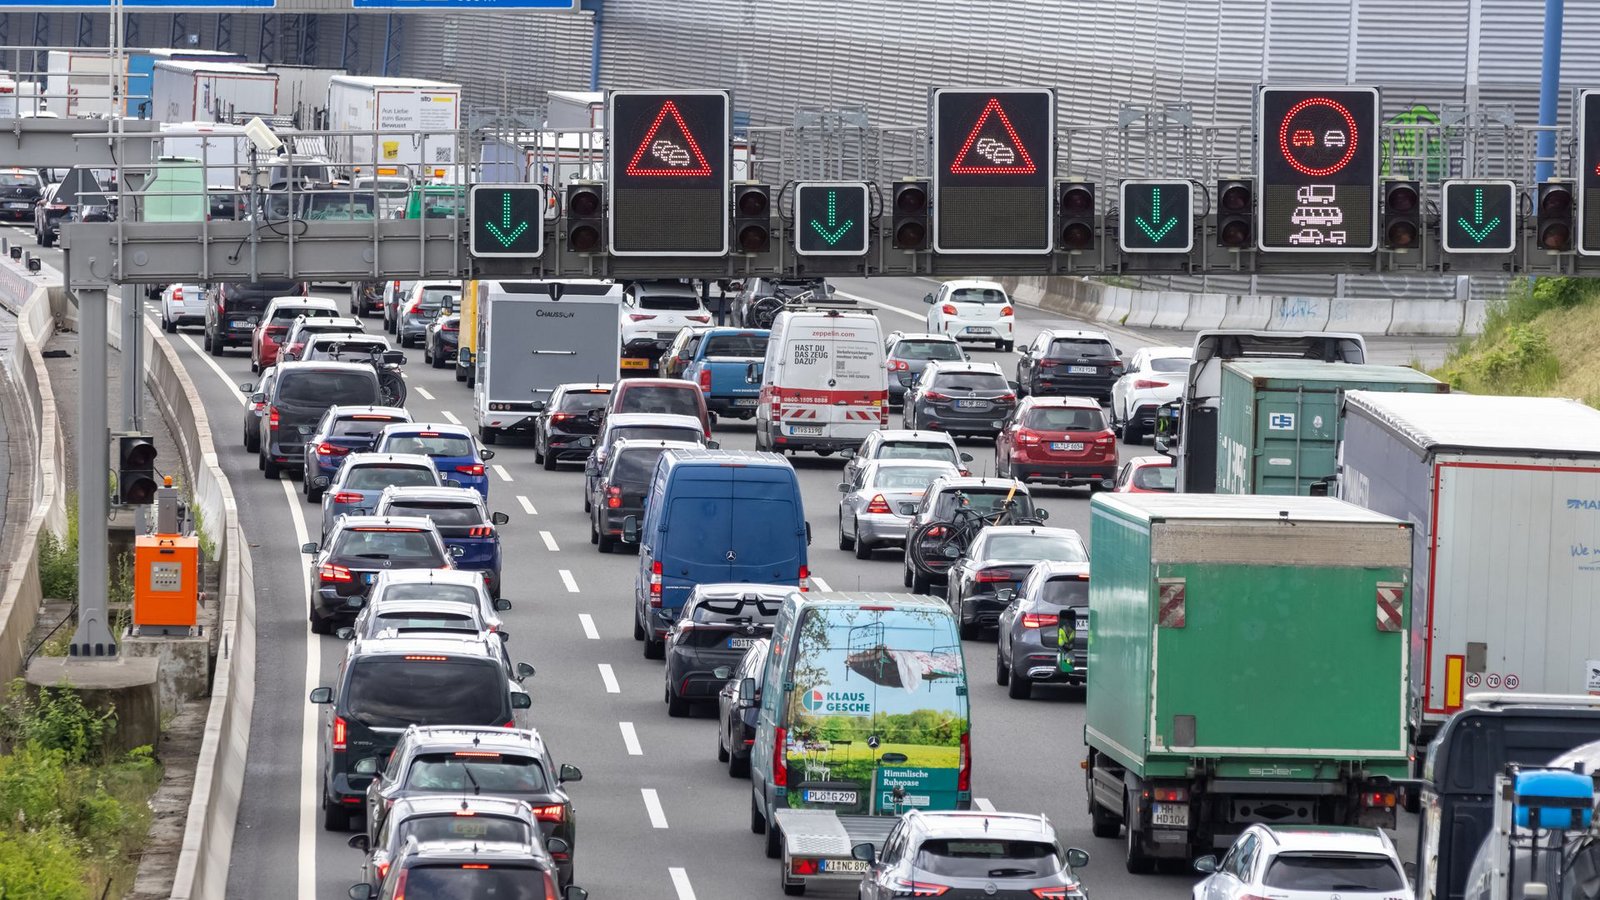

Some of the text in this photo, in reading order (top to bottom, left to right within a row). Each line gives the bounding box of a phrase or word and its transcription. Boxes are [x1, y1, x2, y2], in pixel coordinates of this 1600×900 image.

[794, 344, 813, 352] HAST
[810, 351, 828, 359] ZEUG
[732, 639, 742, 647] HO
[1468, 675, 1479, 685] 60
[1489, 677, 1499, 685] 70
[1506, 678, 1517, 686] 80
[826, 692, 865, 701] KLAUS
[826, 703, 870, 712] GESCHE
[883, 769, 929, 778] Himmlische
[1248, 764, 1302, 776] spier
[883, 778, 919, 787] Ruheoase
[831, 792, 838, 801] G
[838, 792, 856, 802] 299
[1161, 804, 1174, 813] HH
[1156, 814, 1186, 825] HD 104
[825, 861, 835, 871] KI
[842, 861, 853, 871] NC
